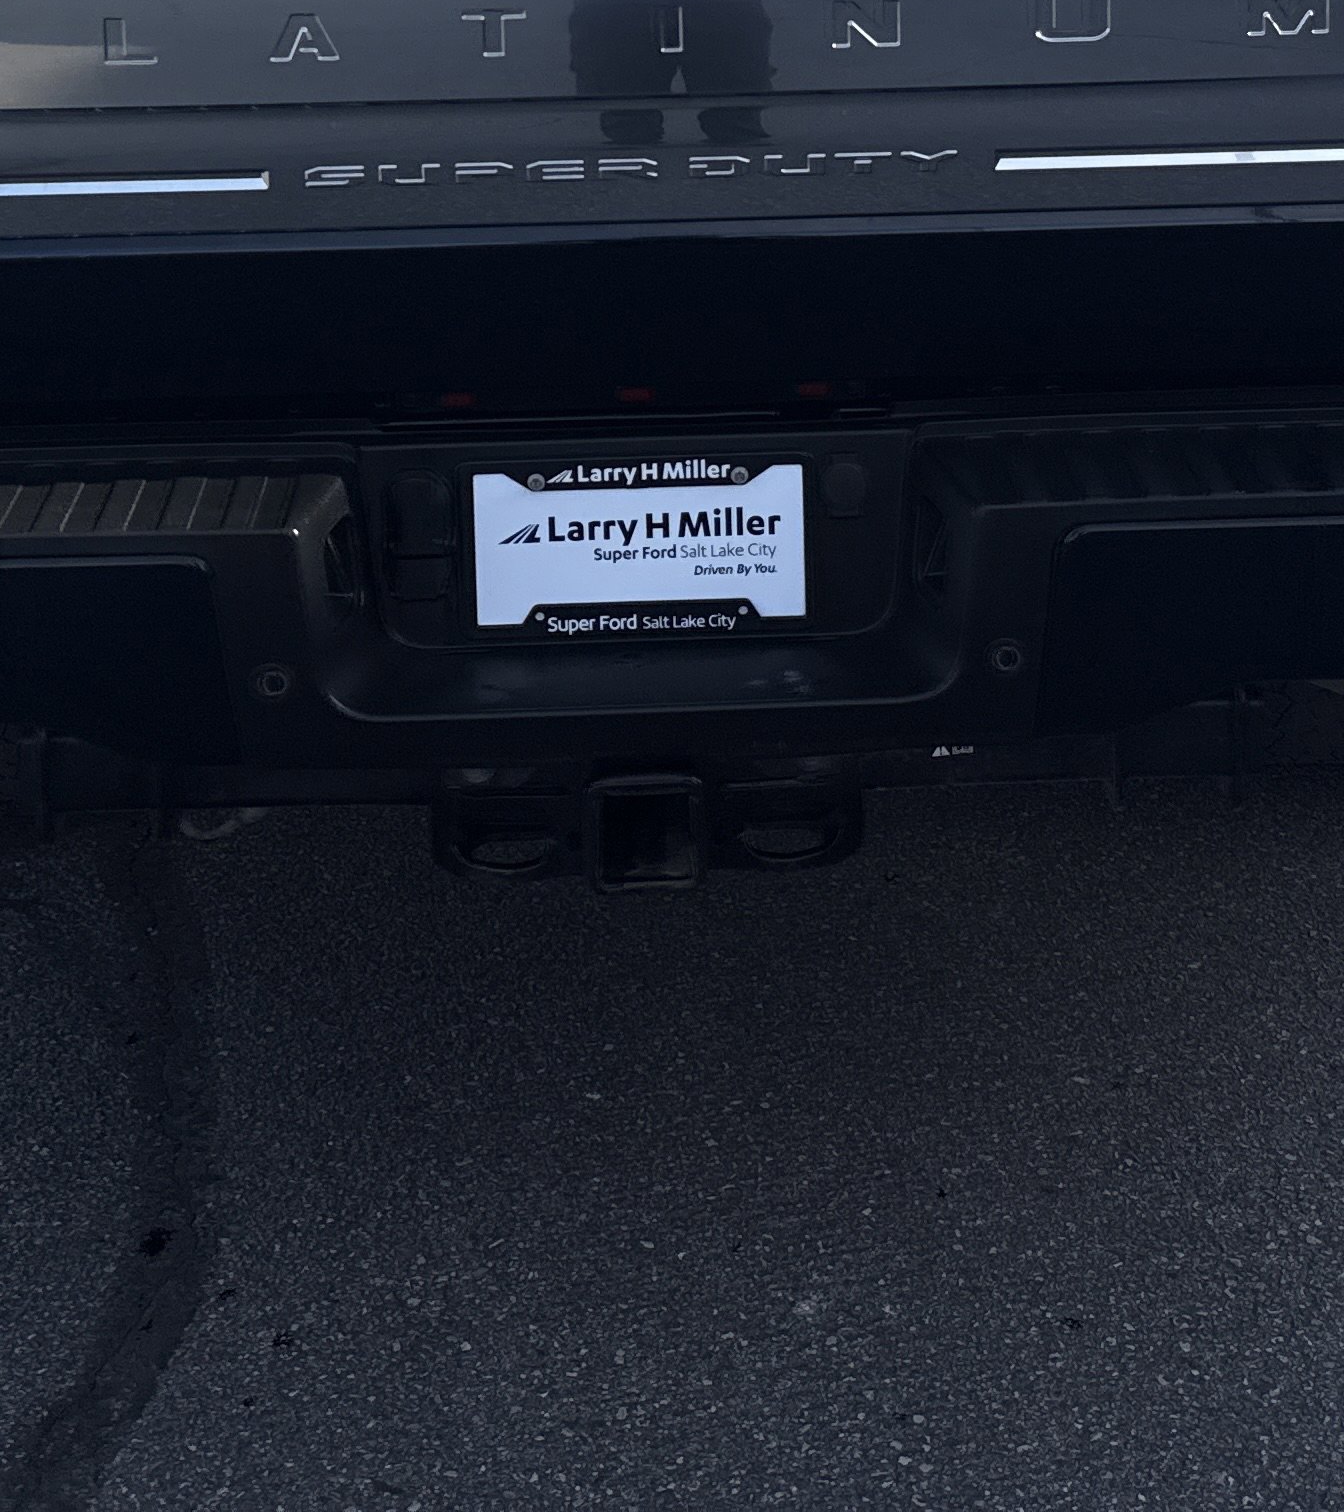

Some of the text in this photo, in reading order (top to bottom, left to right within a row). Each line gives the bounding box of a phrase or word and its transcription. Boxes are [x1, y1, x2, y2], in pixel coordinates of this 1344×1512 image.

[303, 148, 958, 188] SUPER DUTY
[576, 458, 731, 486] Larry H Miller
[547, 506, 781, 546] Larry H Miller
[593, 542, 777, 564] Super Ford Salt Lake City
[693, 563, 733, 576] Driven
[736, 563, 752, 576] By
[547, 612, 737, 635] Super Ford Salt Lake City
